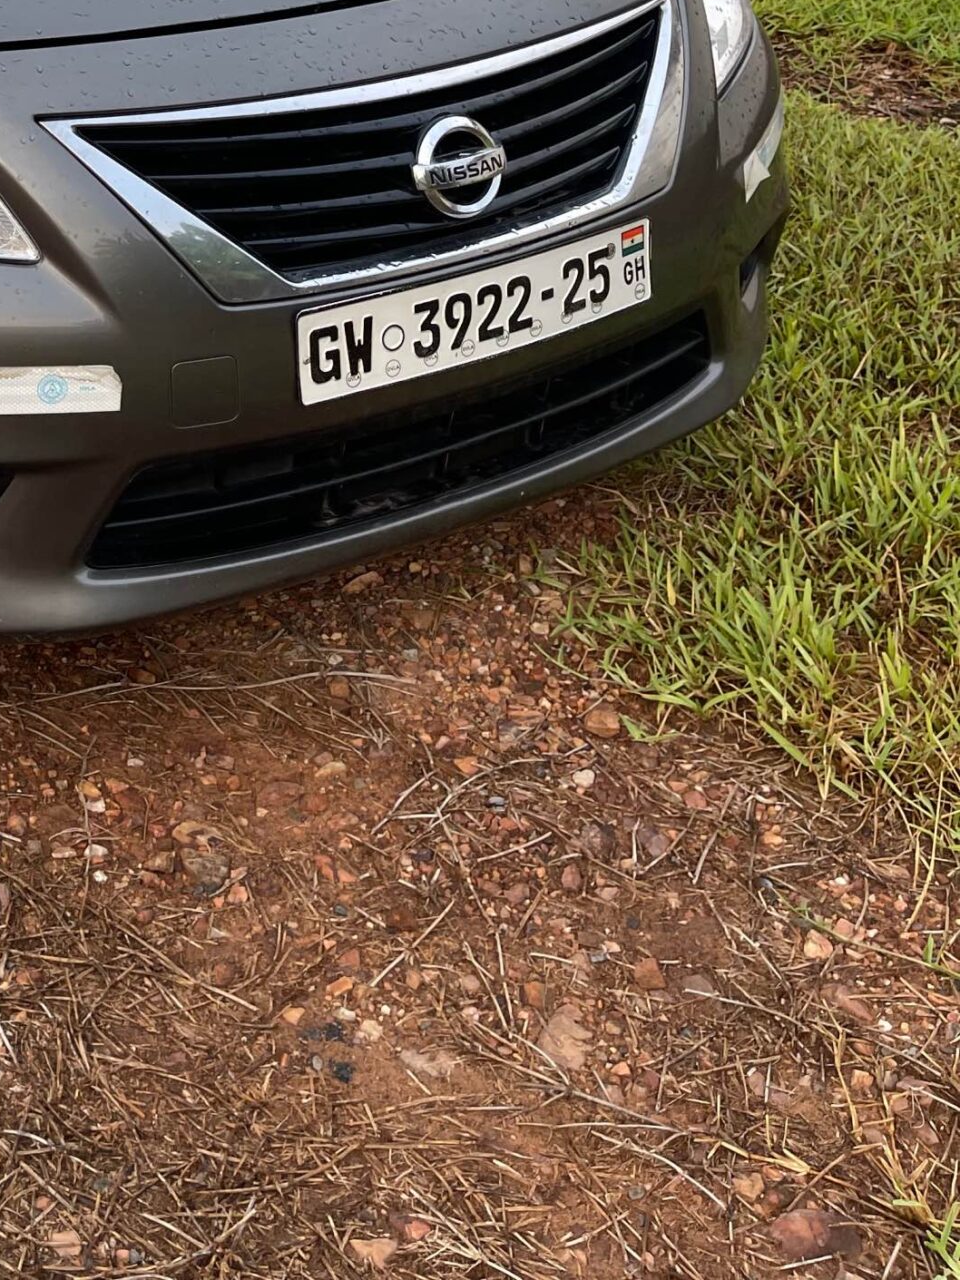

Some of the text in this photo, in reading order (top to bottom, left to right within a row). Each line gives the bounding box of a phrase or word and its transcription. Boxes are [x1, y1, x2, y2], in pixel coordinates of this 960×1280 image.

[429, 154, 503, 185] NISSAN
[623, 255, 646, 285] GH
[309, 247, 611, 384] GW 3922-25
